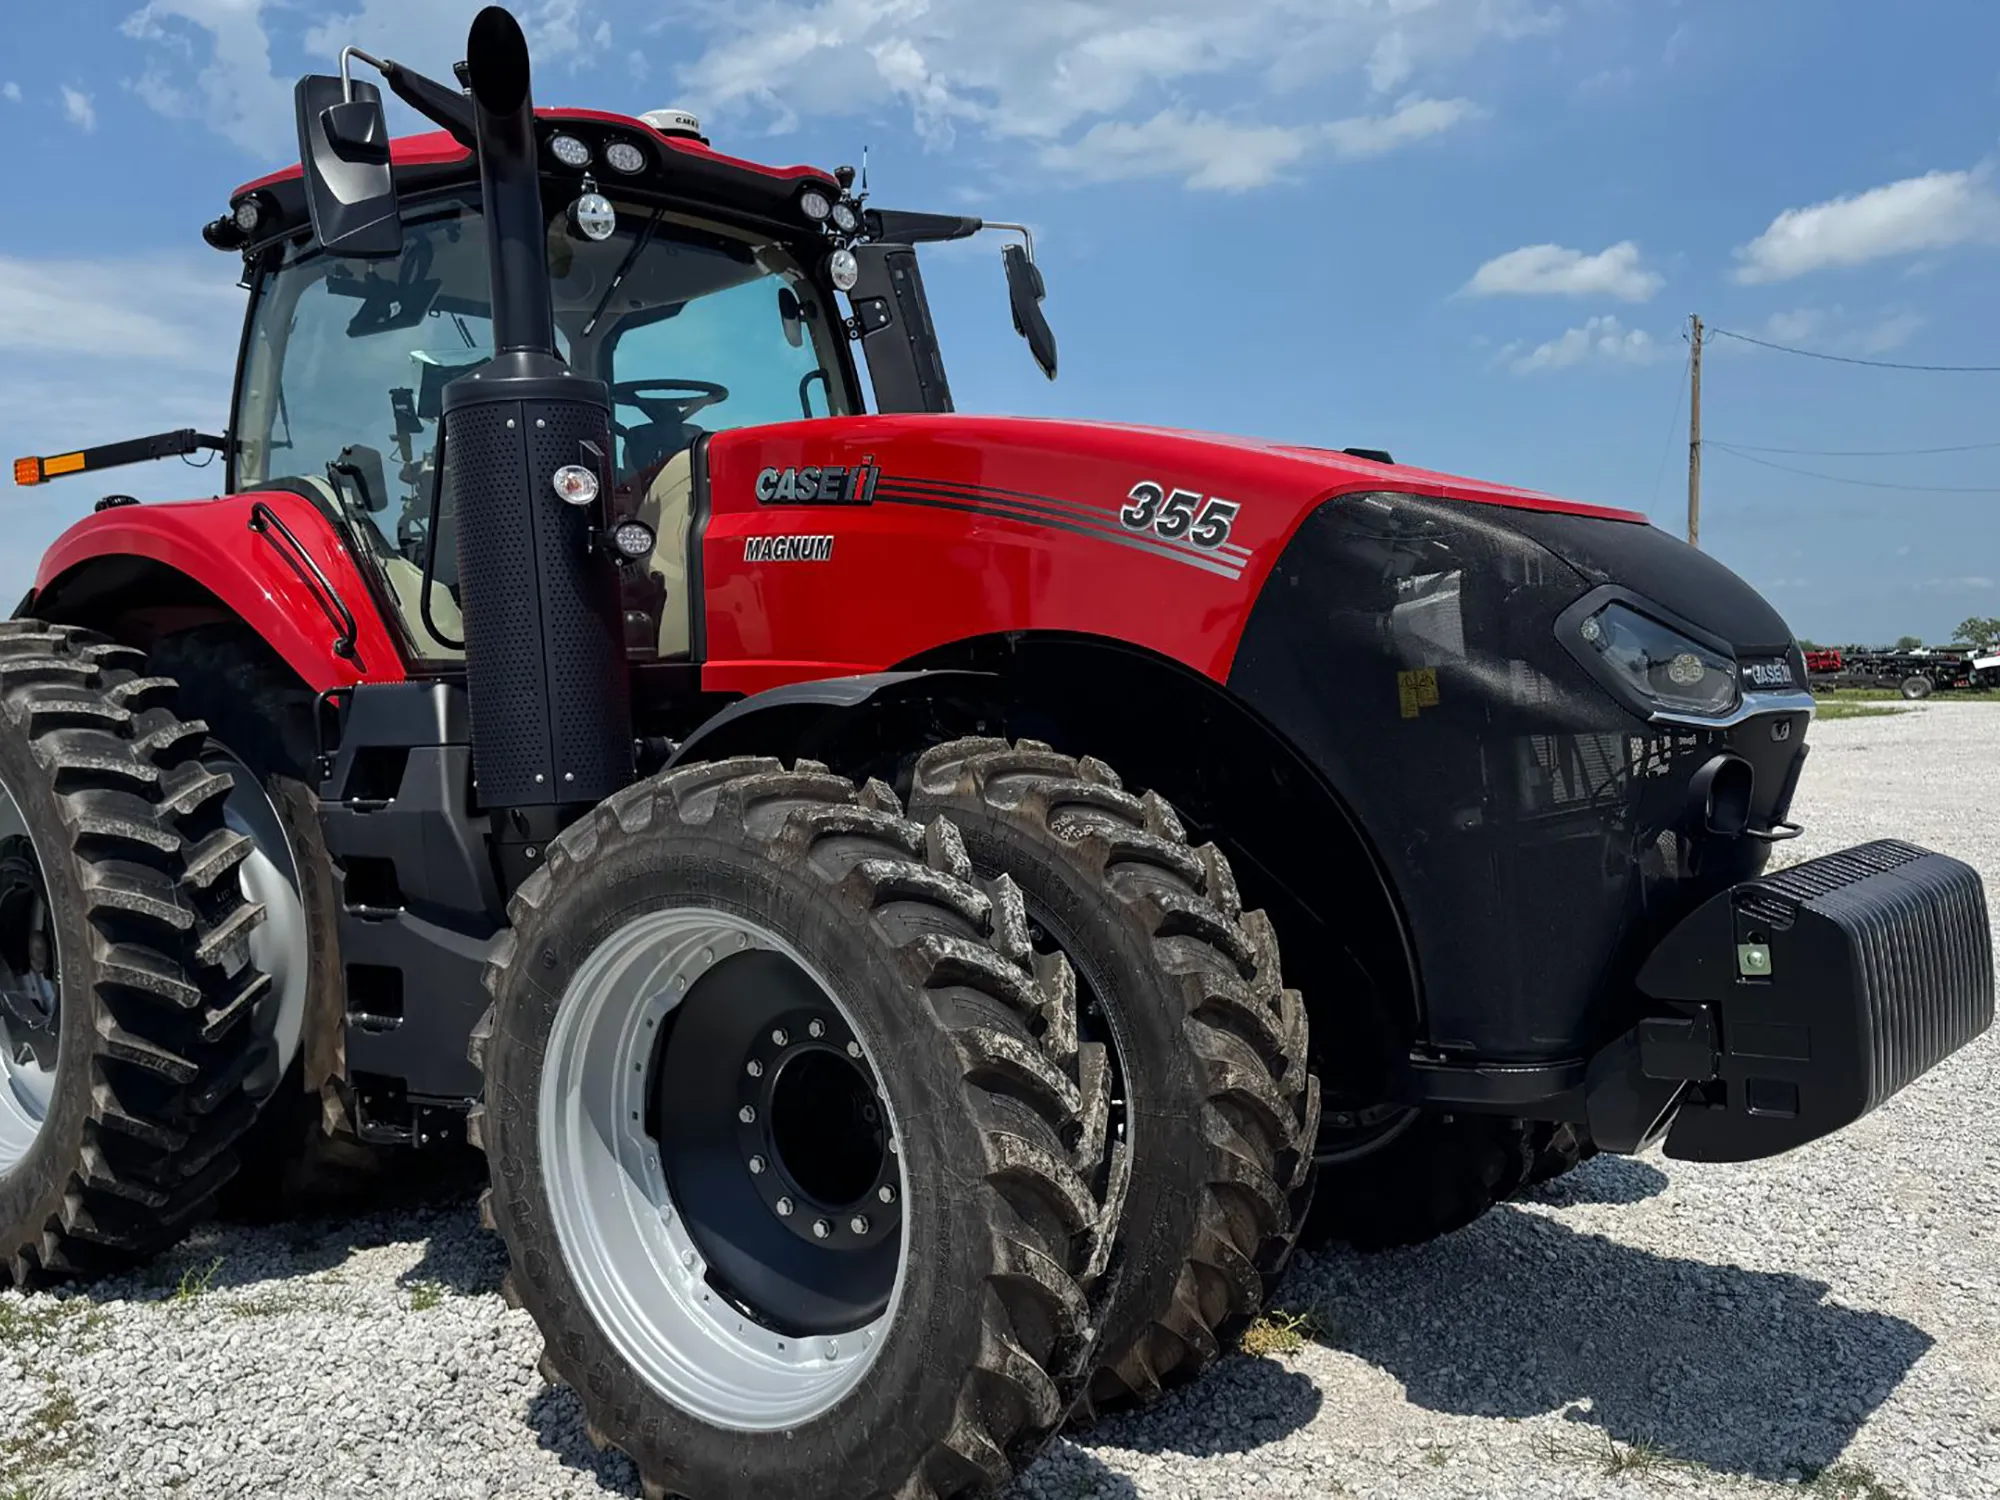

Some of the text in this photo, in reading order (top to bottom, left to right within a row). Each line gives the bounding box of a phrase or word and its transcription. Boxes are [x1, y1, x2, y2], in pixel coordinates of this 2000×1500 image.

[755, 466, 845, 503] CASE
[1121, 481, 1241, 551] 355
[744, 535, 834, 562] MAGNUM
